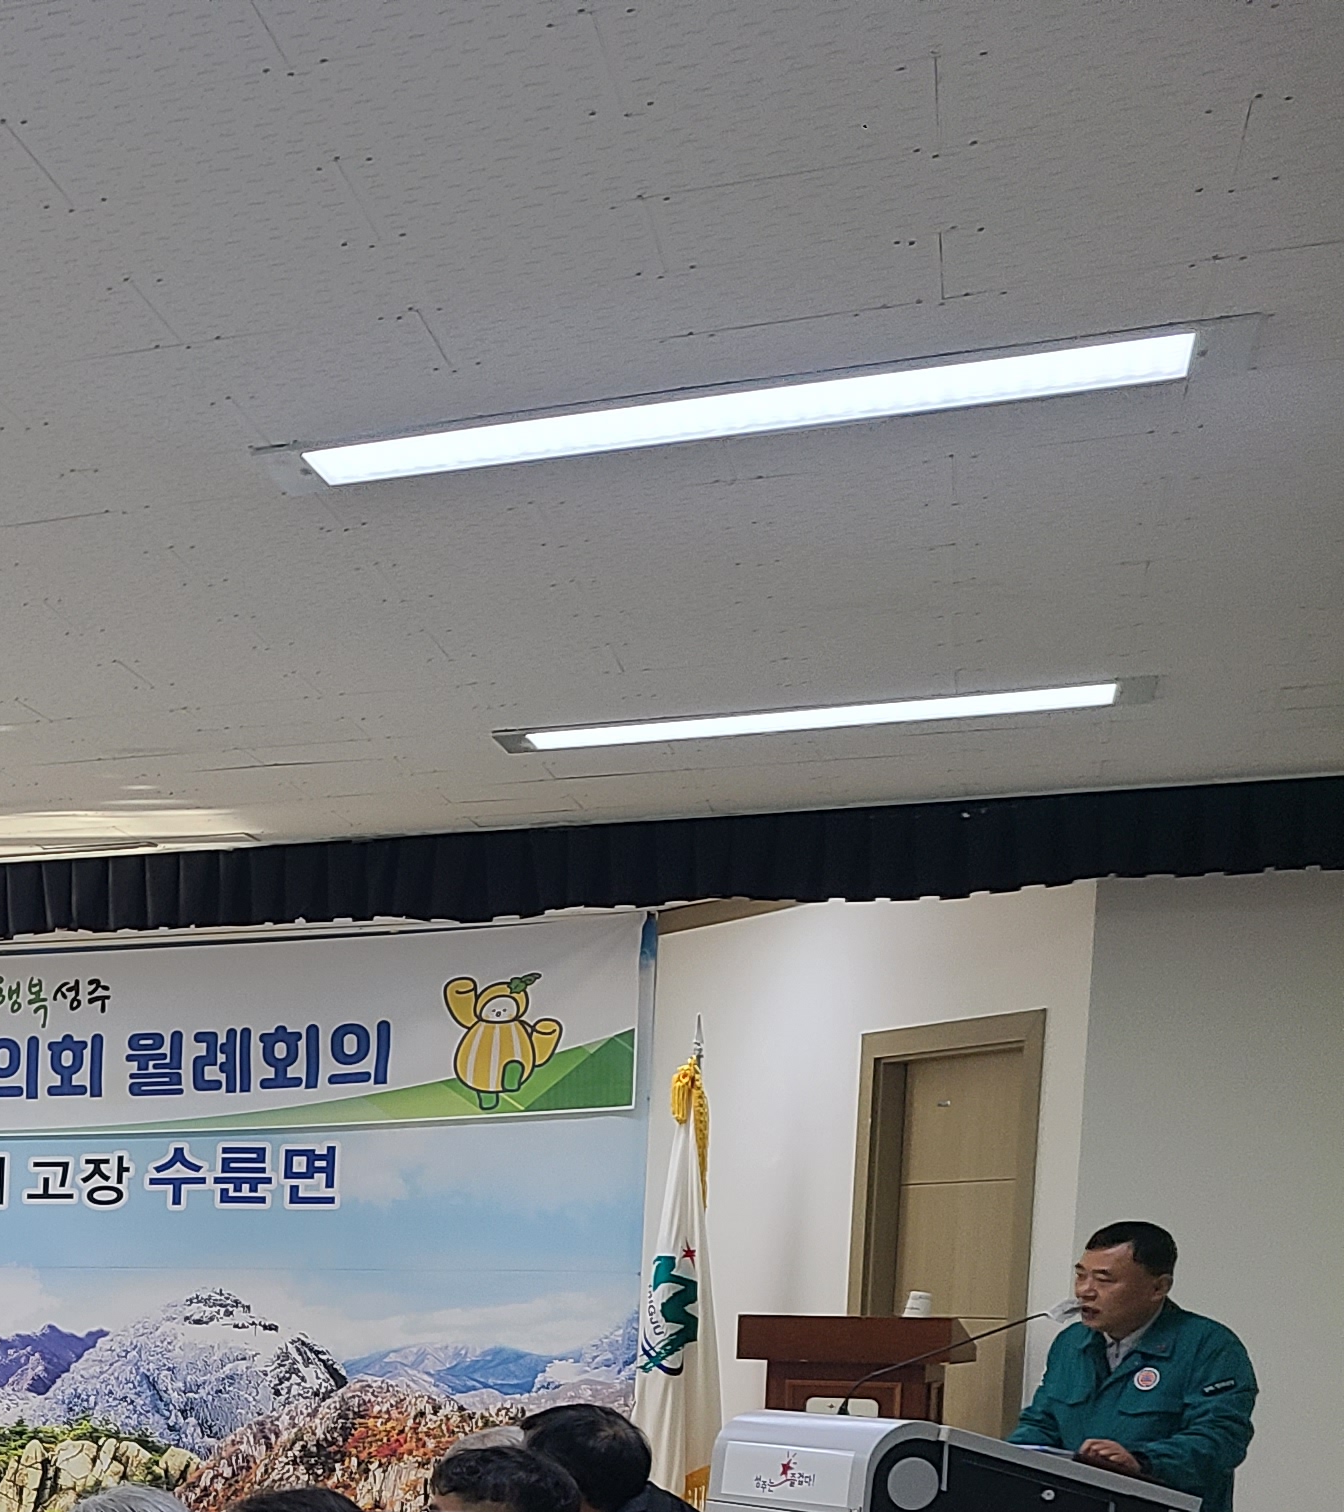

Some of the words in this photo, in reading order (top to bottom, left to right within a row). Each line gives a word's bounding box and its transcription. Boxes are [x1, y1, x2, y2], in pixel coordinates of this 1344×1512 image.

[124, 1019, 392, 1097] 월례회의
[26, 1154, 132, 1206] 고장
[147, 1145, 337, 1206] 수륜면
[754, 1474, 775, 1493] 성주는
[788, 1472, 816, 1487] 즐겁다!
